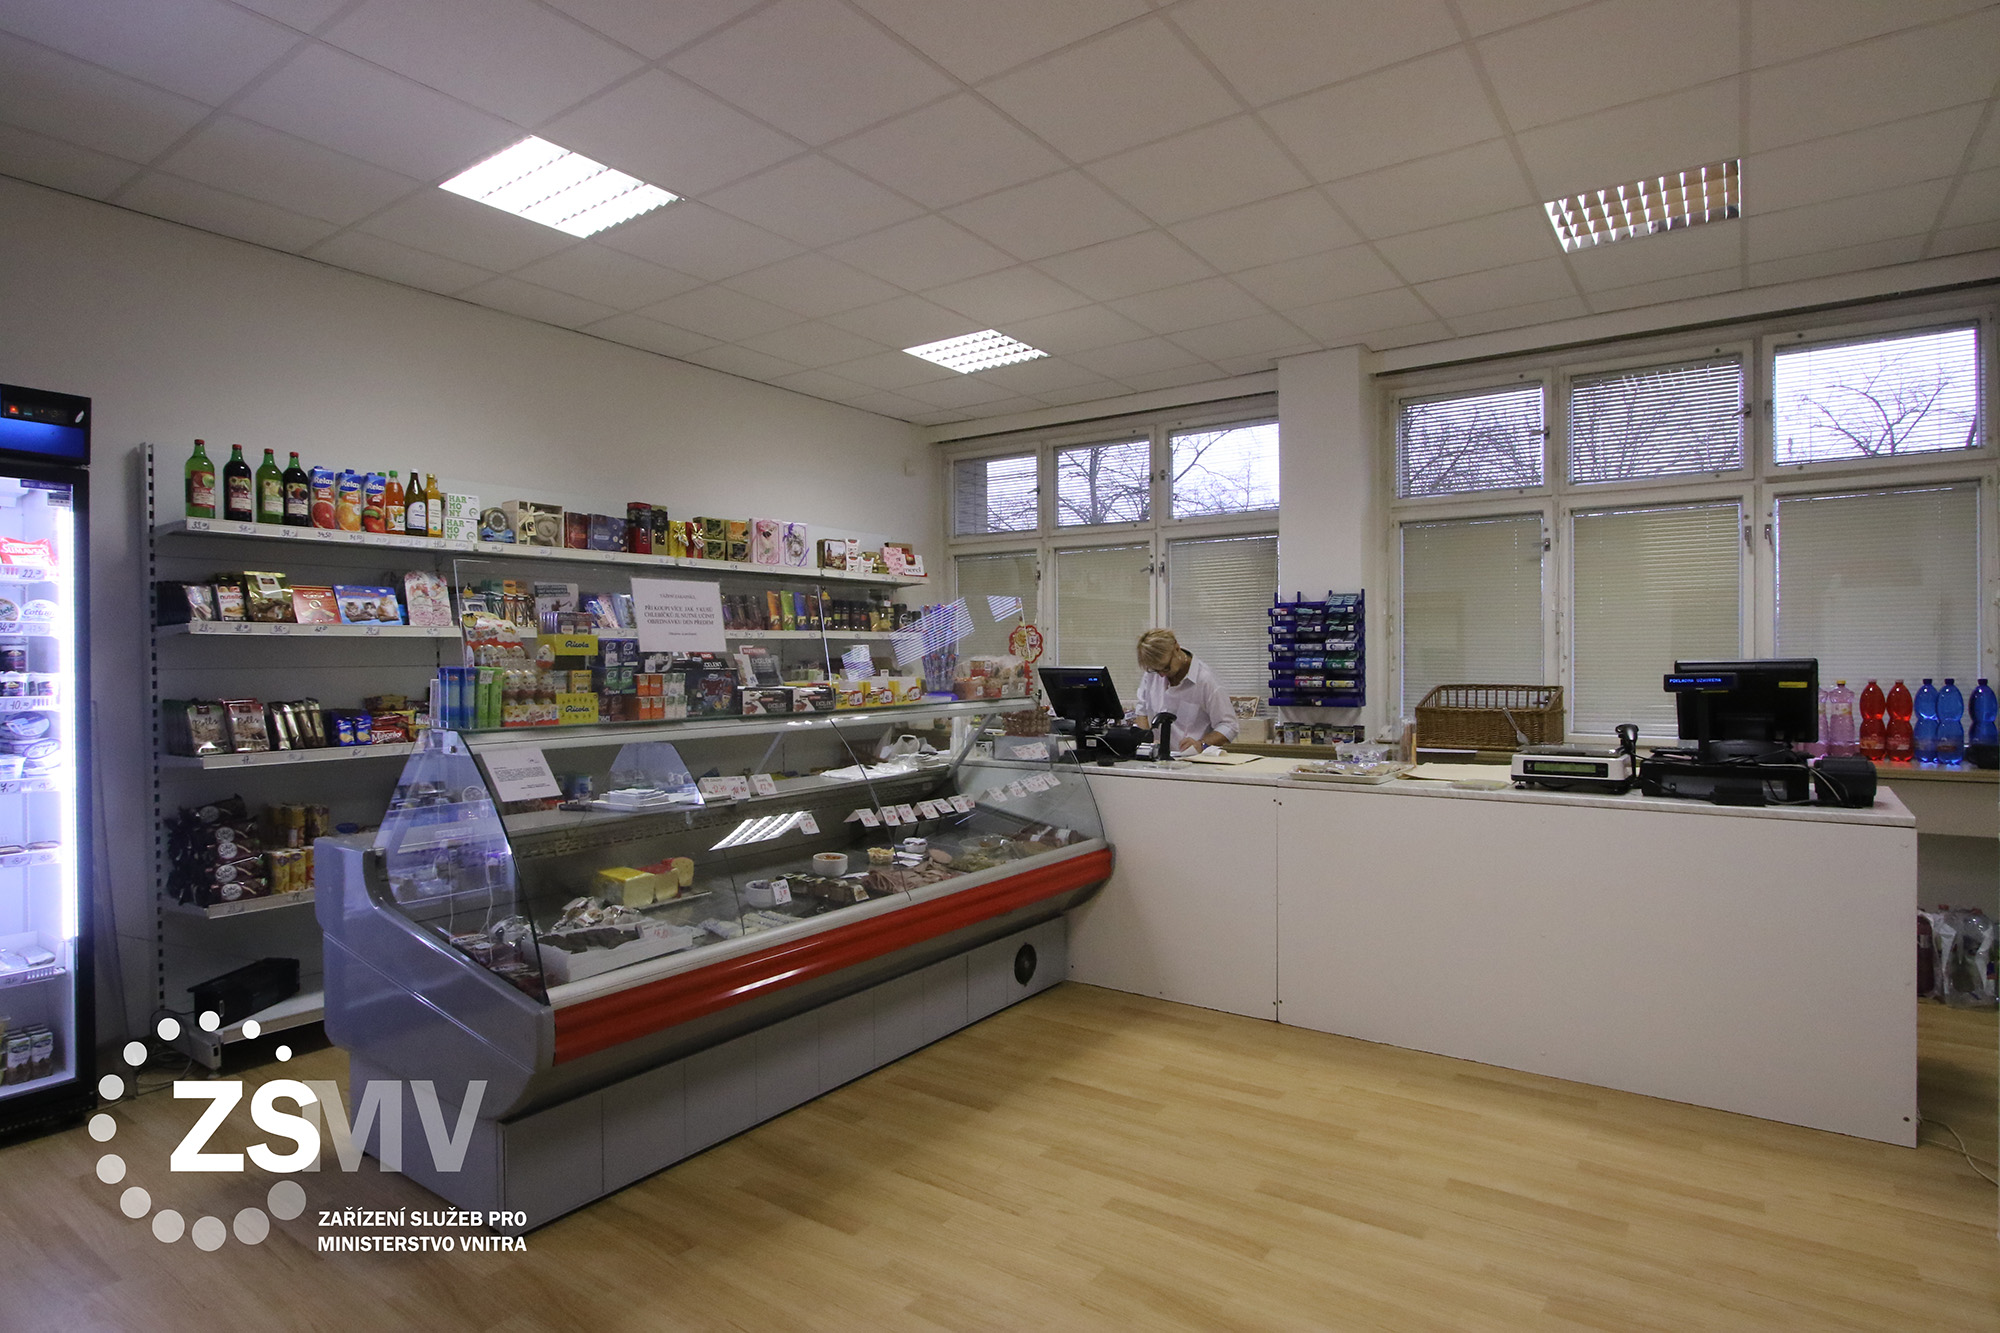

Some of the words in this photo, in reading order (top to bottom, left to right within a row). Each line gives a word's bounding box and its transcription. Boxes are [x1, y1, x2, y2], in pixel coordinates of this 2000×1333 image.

[315, 476, 333, 485] Relax
[341, 480, 360, 488] Relax
[367, 483, 385, 491] Relax
[448, 494, 467, 503] HAR
[449, 502, 462, 510] MO
[449, 509, 461, 517] NY
[446, 518, 465, 527] HAR
[565, 640, 590, 648] Ricola
[565, 705, 590, 713] Ricola
